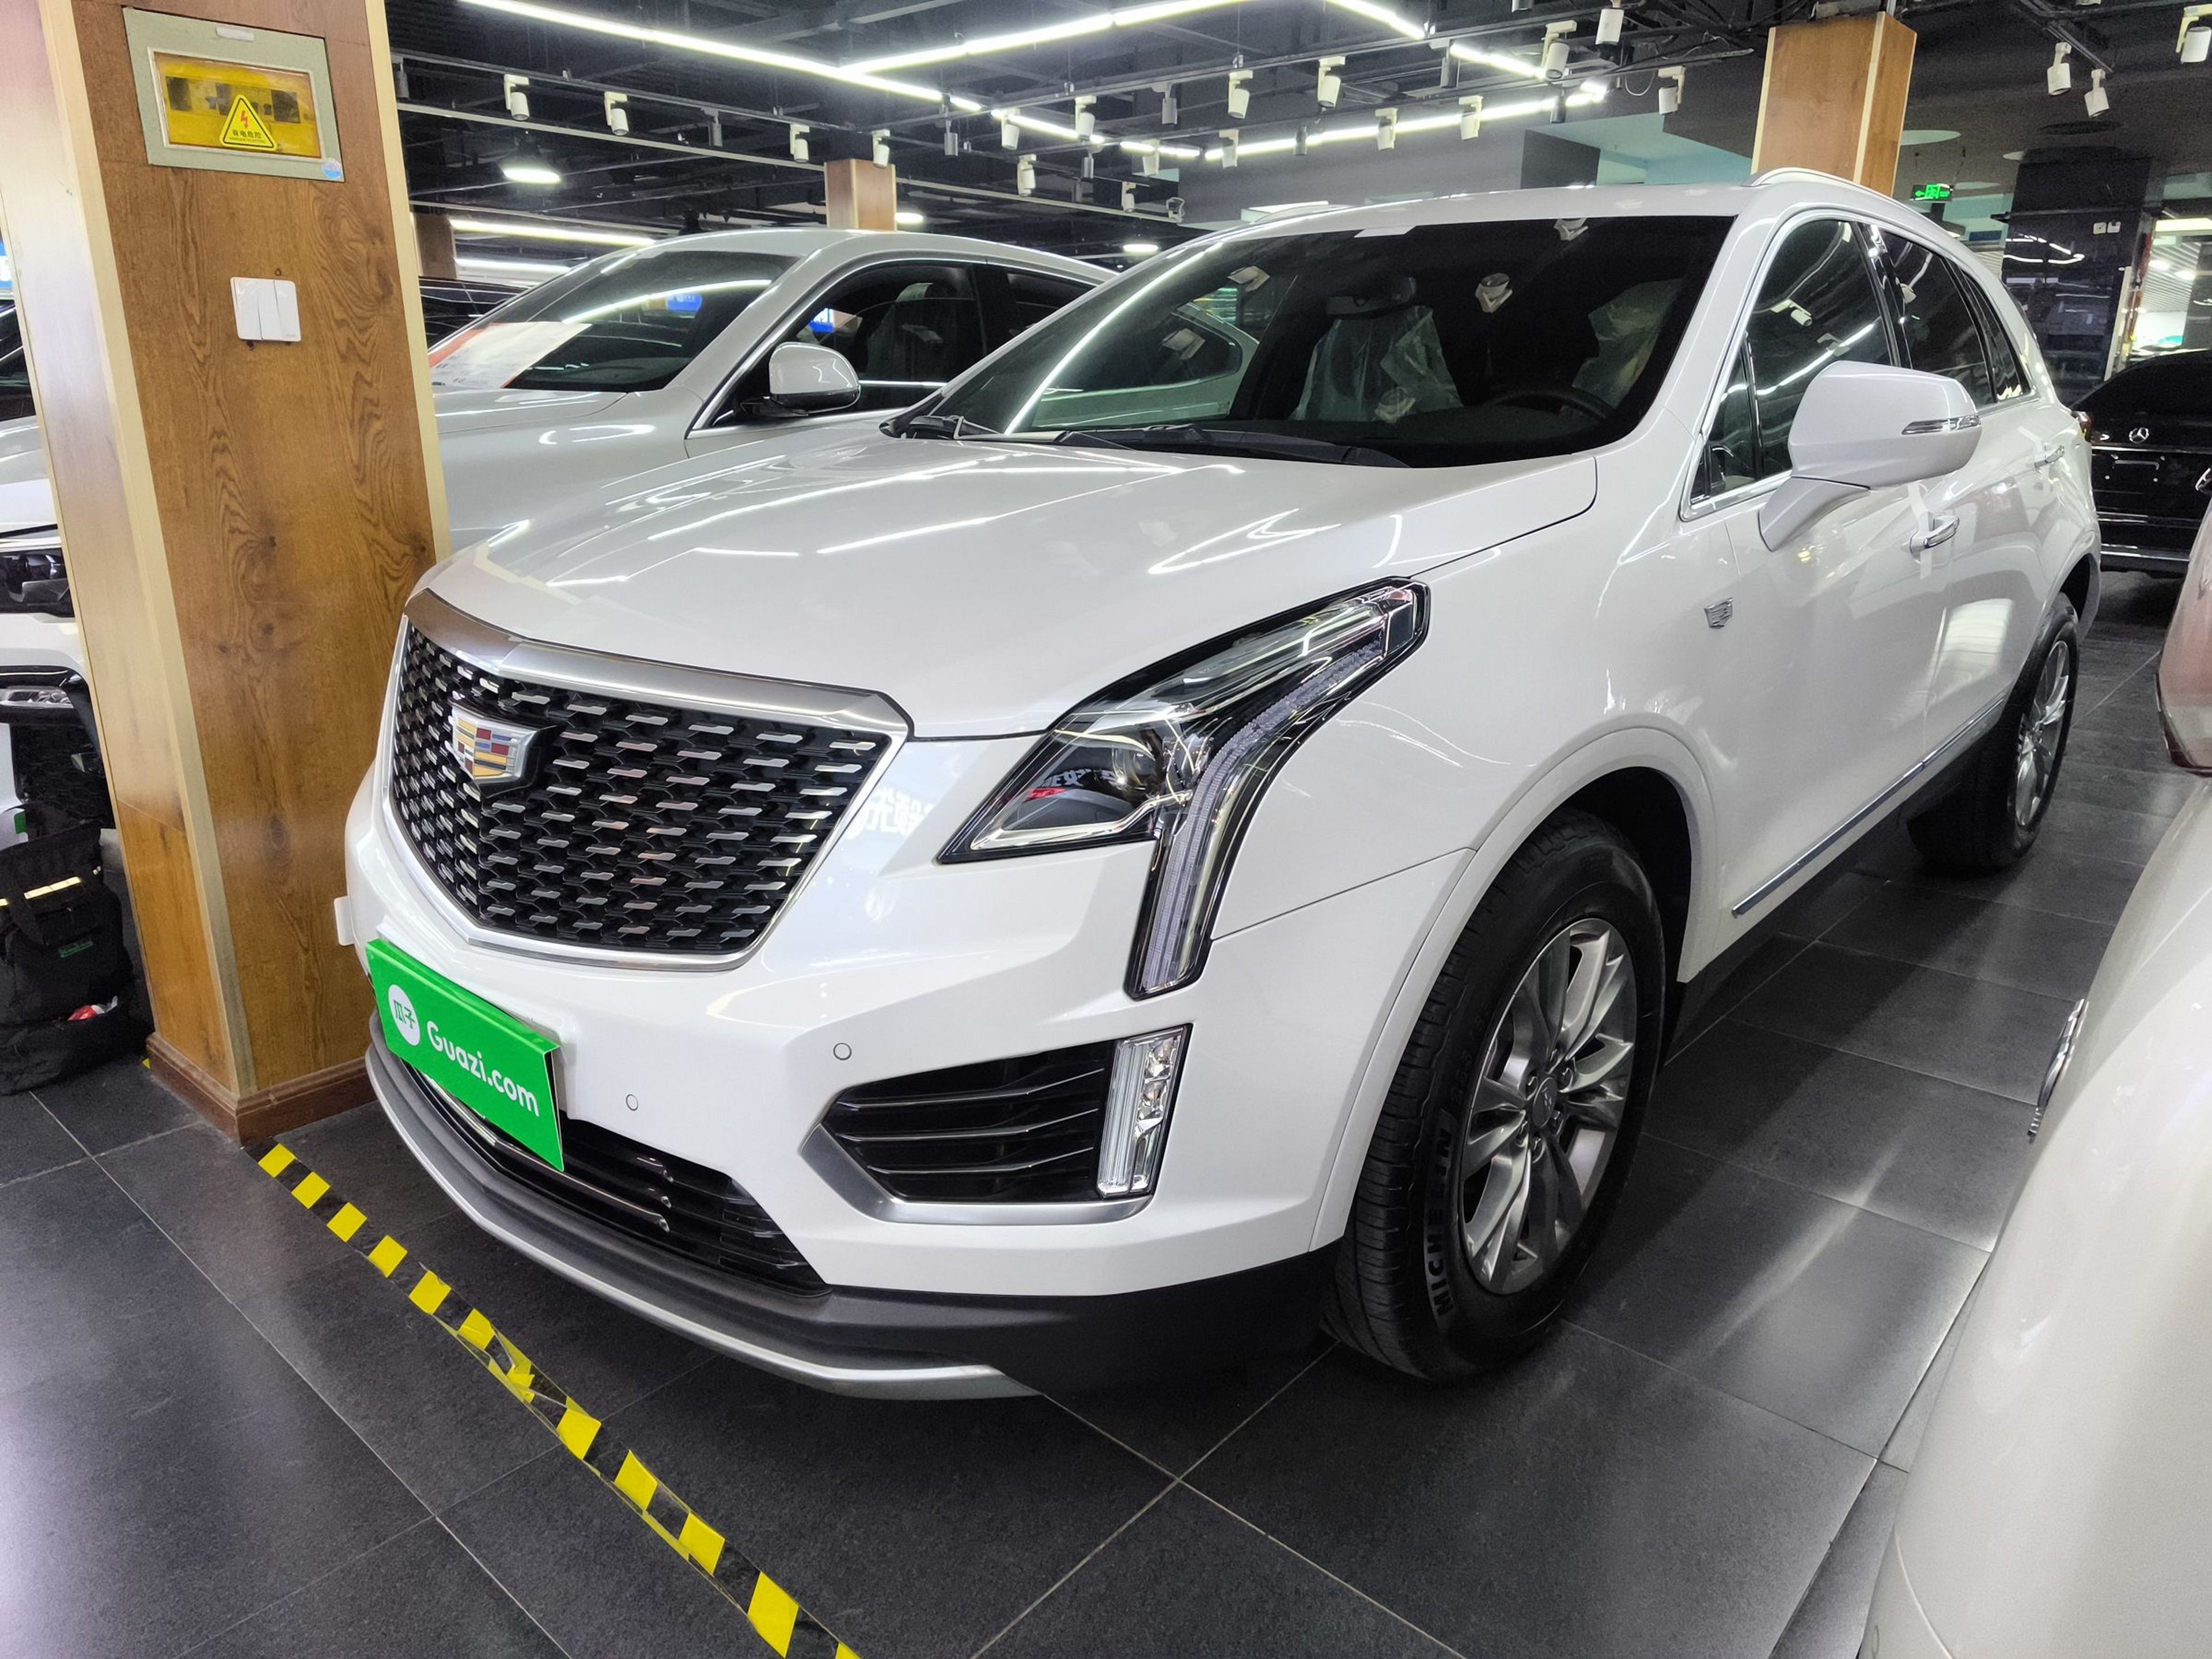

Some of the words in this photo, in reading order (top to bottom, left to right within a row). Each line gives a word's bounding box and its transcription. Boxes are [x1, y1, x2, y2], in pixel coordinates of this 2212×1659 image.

[393, 999, 416, 1029] 瓜子
[427, 1020, 540, 1118] Guazi.com
[1427, 1127, 1455, 1317] MICHELIN
